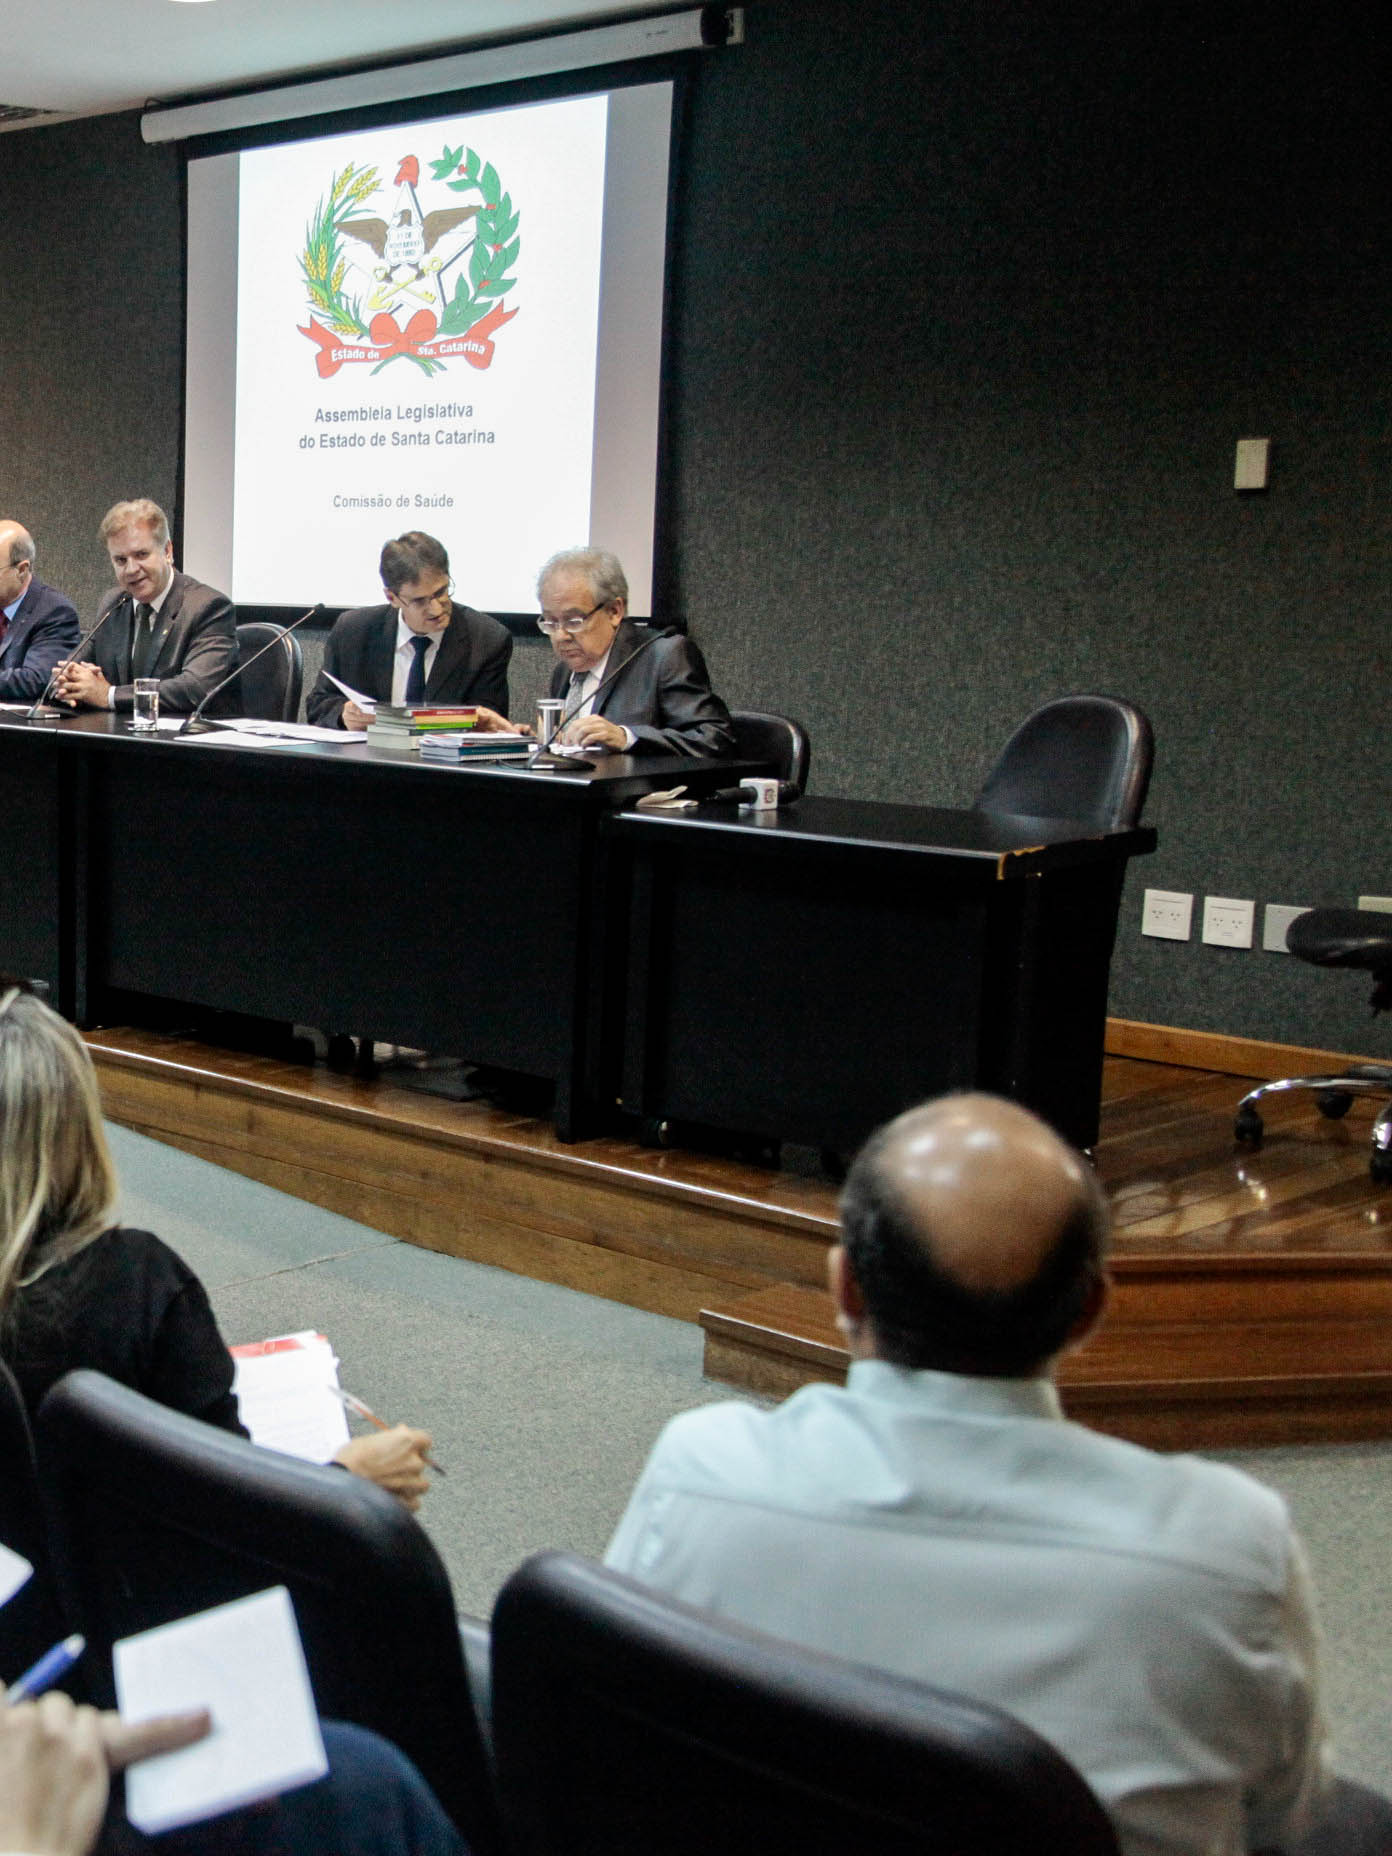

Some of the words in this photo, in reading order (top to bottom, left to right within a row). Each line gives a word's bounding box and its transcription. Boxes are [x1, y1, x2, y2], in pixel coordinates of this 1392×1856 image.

[331, 348, 365, 362] Estado
[367, 349, 380, 360] de
[417, 346, 437, 356] Sta.
[439, 340, 486, 355] Catarina
[315, 406, 391, 422] Assembleia
[397, 402, 473, 423] Legislativa
[299, 435, 315, 449] do
[320, 433, 366, 448] Estado
[370, 432, 386, 446] de
[392, 432, 430, 446] Santa
[435, 429, 495, 445] Catarina
[333, 494, 392, 507] Comissão
[396, 495, 410, 507] de
[415, 494, 454, 507] Saúde
